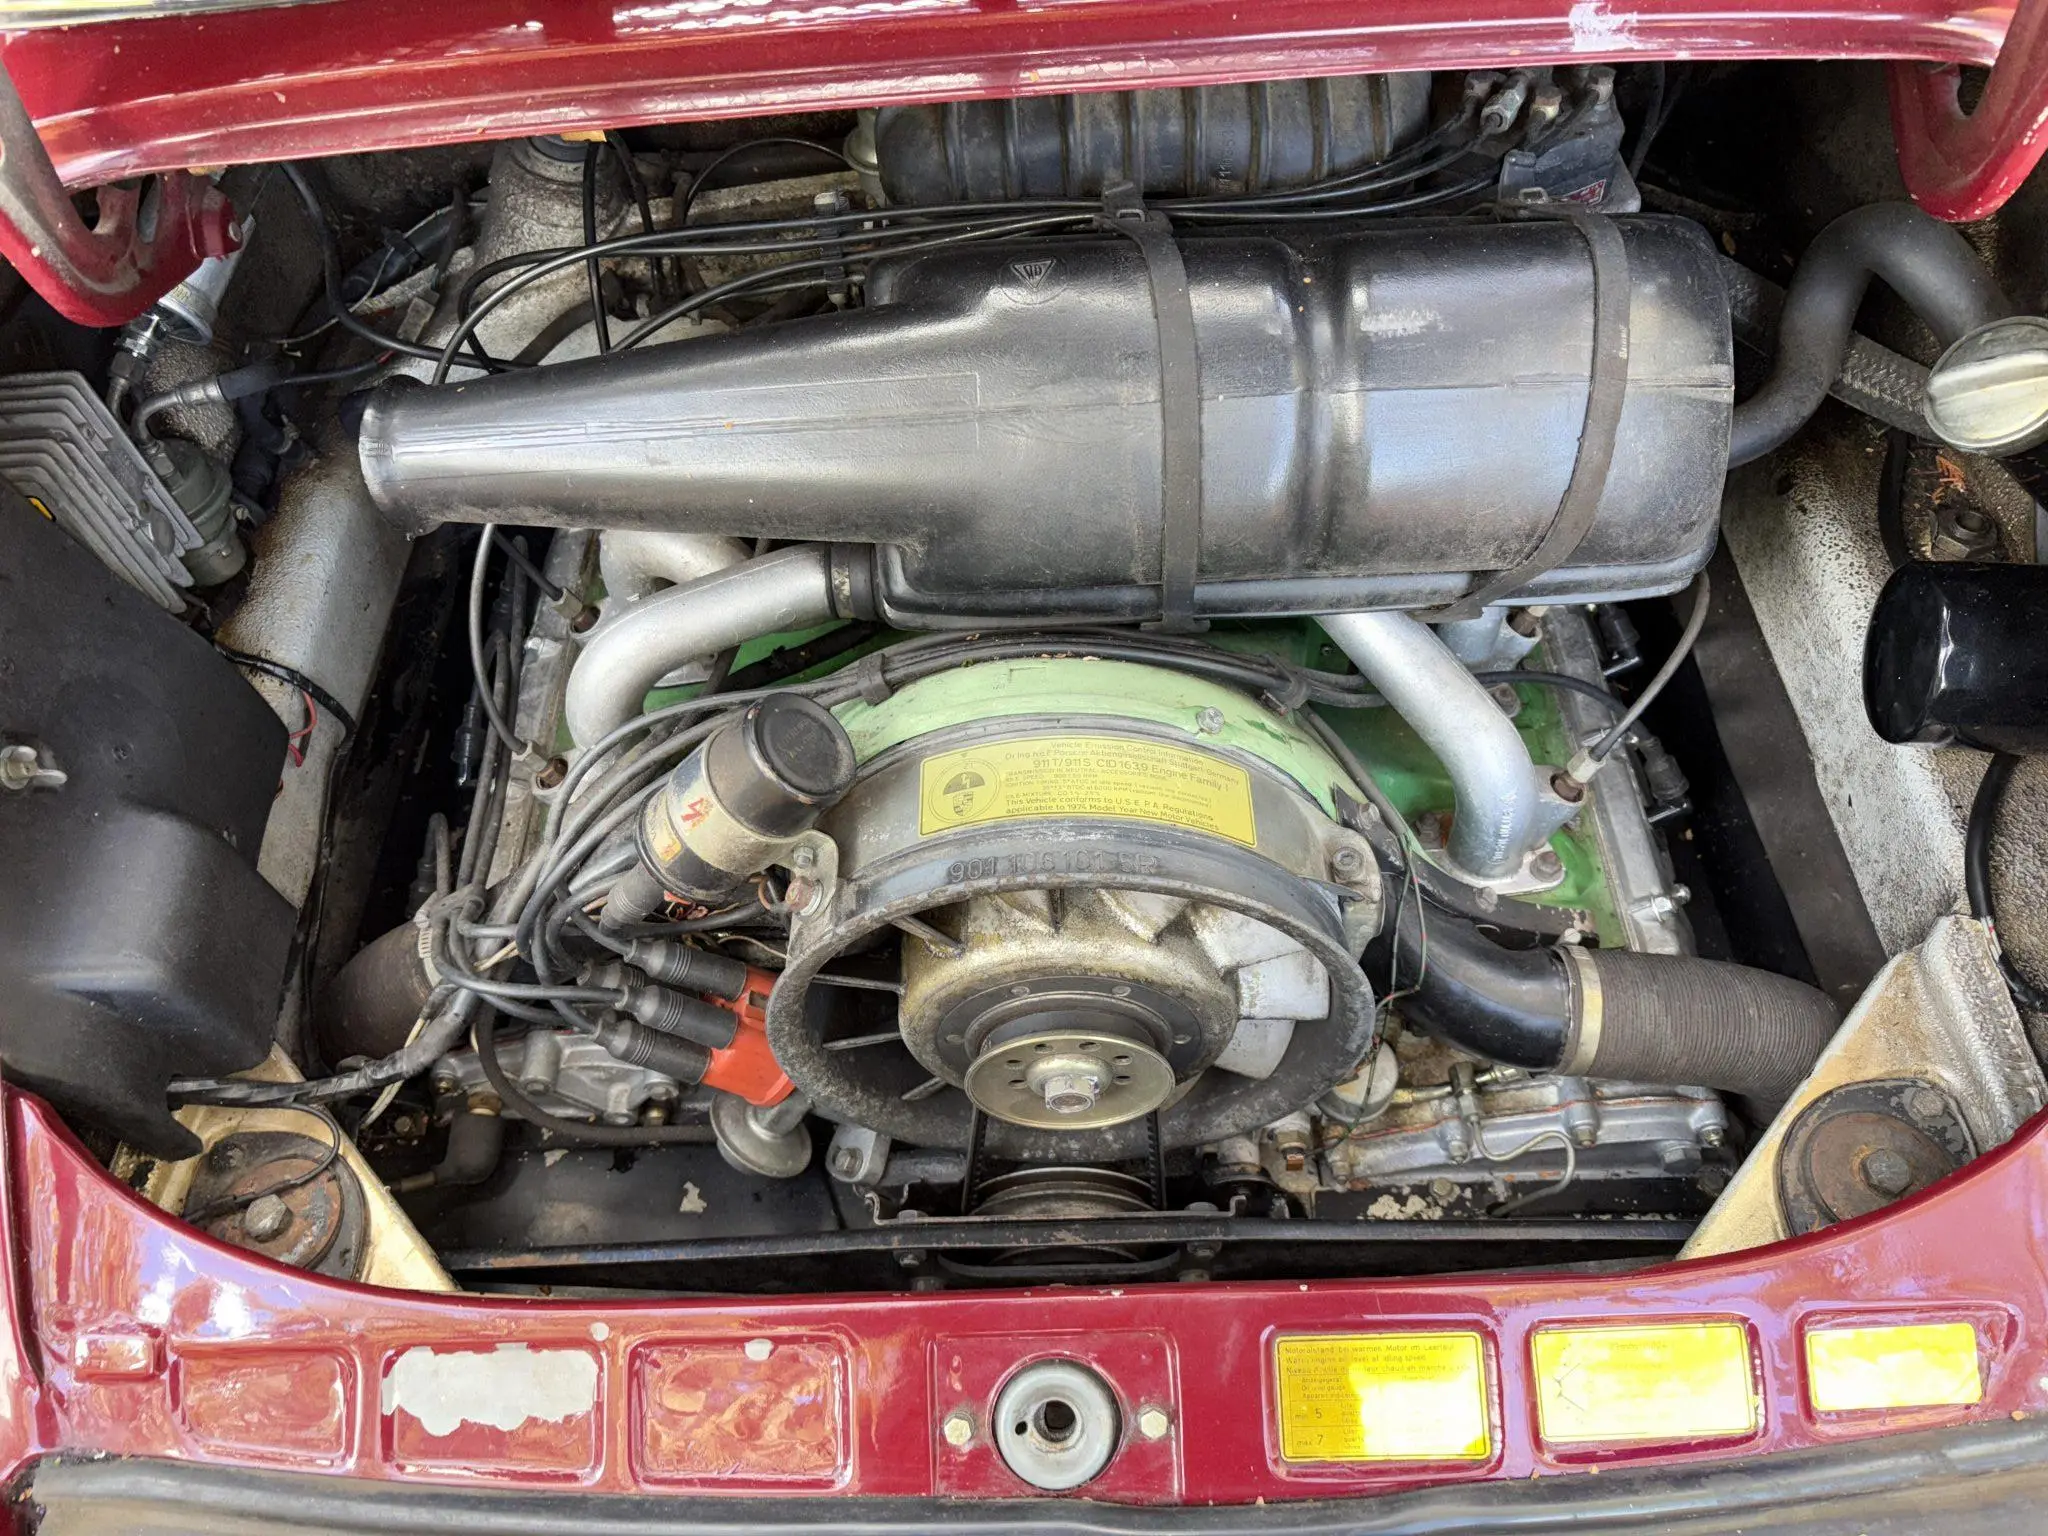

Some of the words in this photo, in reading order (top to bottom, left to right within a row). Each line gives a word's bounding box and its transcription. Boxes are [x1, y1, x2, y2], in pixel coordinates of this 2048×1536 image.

[1096, 758, 1117, 768] CID
[1152, 764, 1189, 780] Engine
[1190, 773, 1222, 791] Family
[1025, 796, 1057, 804] Vehicle
[1104, 796, 1113, 804] to
[1006, 804, 1054, 814] applicable
[1056, 803, 1066, 811] to
[1067, 803, 1087, 811] 1974
[1089, 804, 1116, 812] Model
[1119, 804, 1138, 813] Year
[1139, 807, 1158, 816] New
[1161, 810, 1183, 822] Motor
[950, 856, 998, 883] 901
[1386, 1344, 1407, 1352] Motor
[1315, 1408, 1322, 1419] 5
[1317, 1434, 1324, 1446] 7
